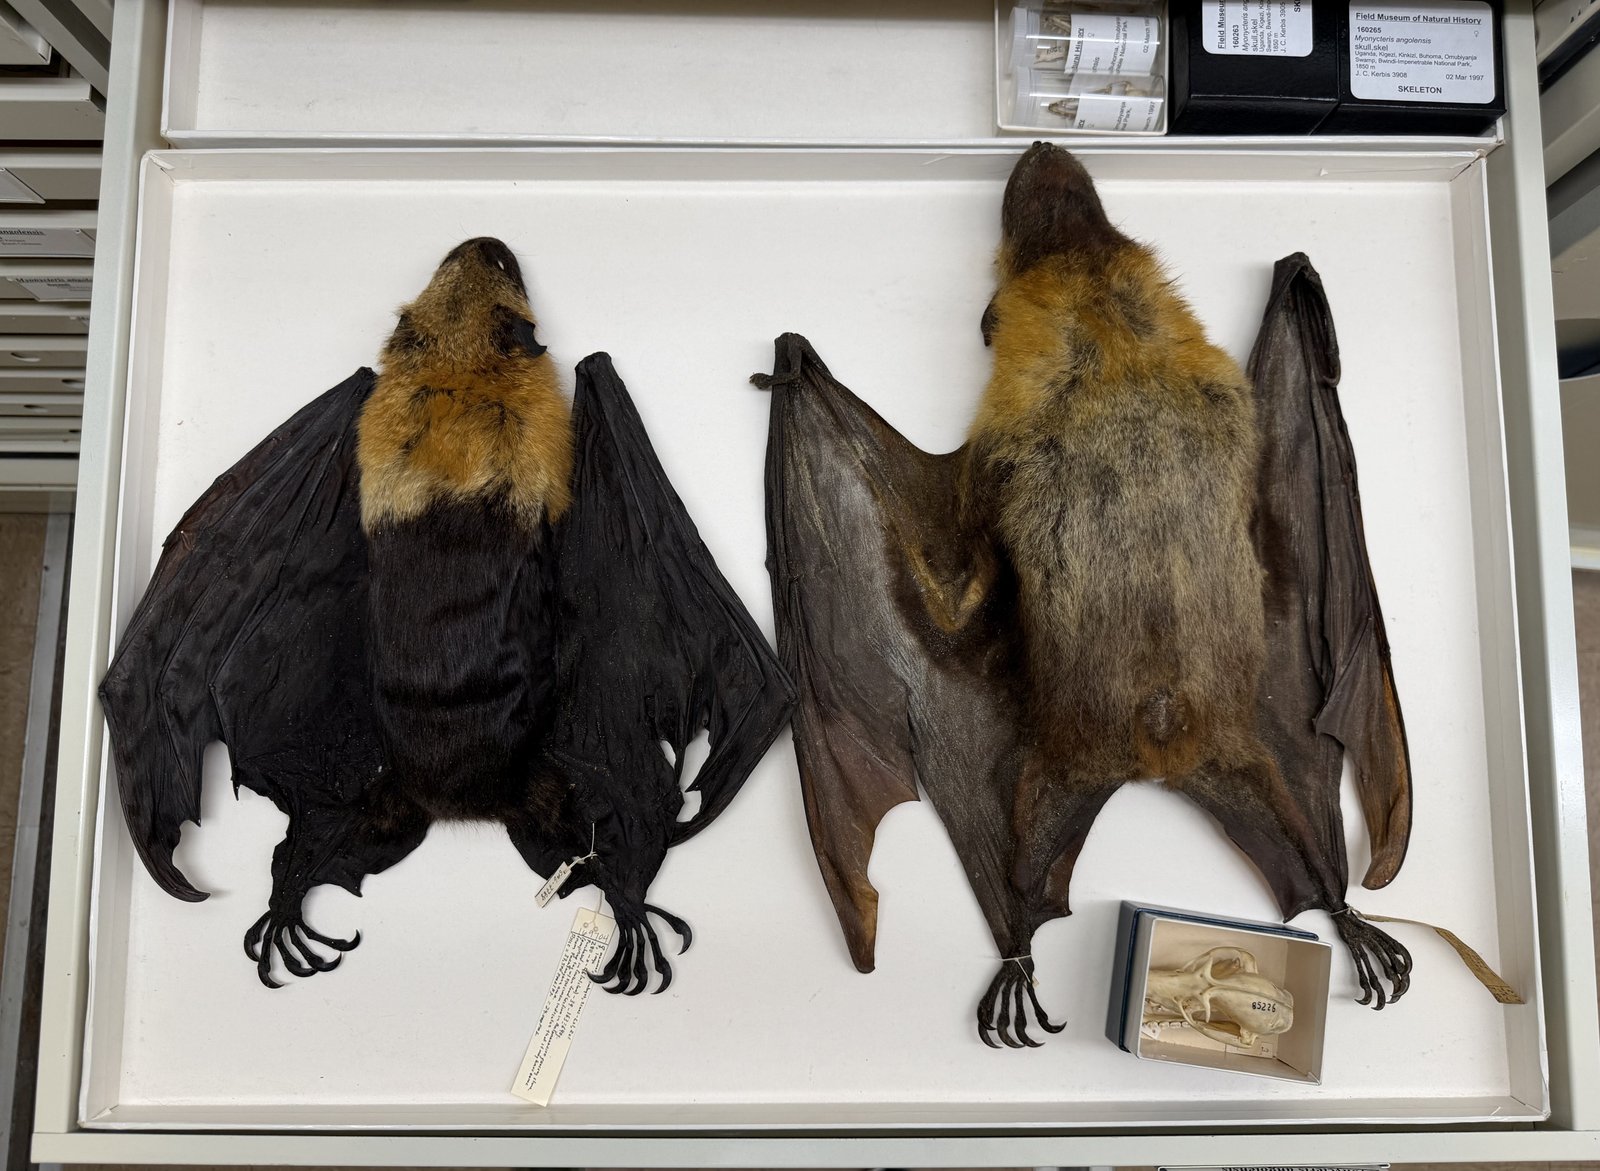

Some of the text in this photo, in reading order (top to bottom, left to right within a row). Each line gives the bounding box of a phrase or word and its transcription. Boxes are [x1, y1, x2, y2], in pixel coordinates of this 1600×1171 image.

[1377, 13, 1410, 22] Museum
[1453, 17, 1481, 25] History
[1355, 35, 1431, 45] Myonycteris angolensis
[1355, 43, 1388, 51] skull,skel
[1398, 85, 1442, 94] SKELETON
